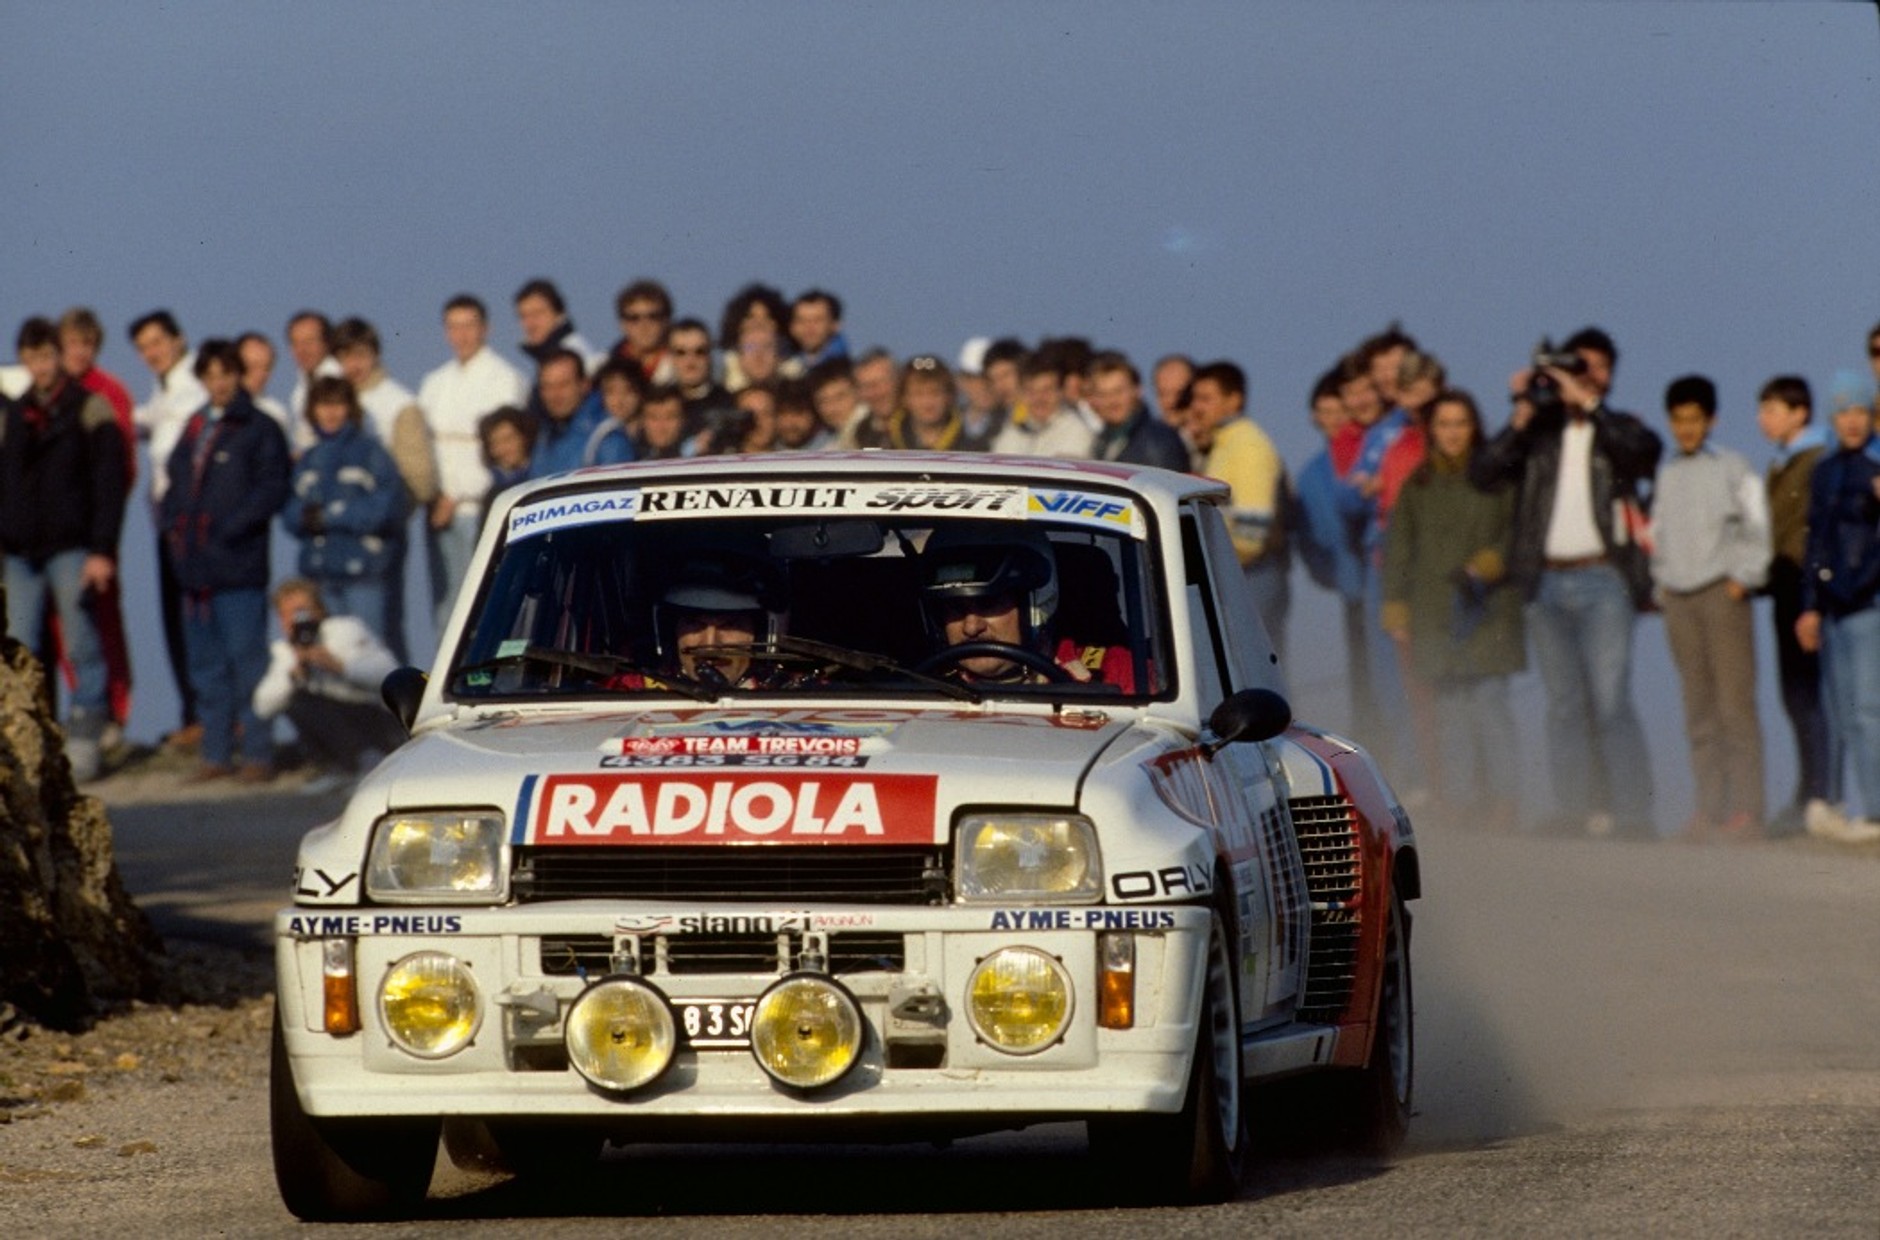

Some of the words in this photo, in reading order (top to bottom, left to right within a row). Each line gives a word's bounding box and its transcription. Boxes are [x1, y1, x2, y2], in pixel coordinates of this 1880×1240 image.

[639, 487, 856, 513] RENAULT
[1036, 490, 1126, 519] VIFF
[511, 497, 636, 532] PRIMAGAZ
[683, 736, 750, 752] TEAM
[757, 736, 857, 753] TREVOIS
[545, 780, 885, 837] RADIOLA
[1111, 863, 1213, 899] ORLY
[289, 915, 462, 934] AYME-PNEUS
[990, 910, 1176, 930] AYME-PNEUS
